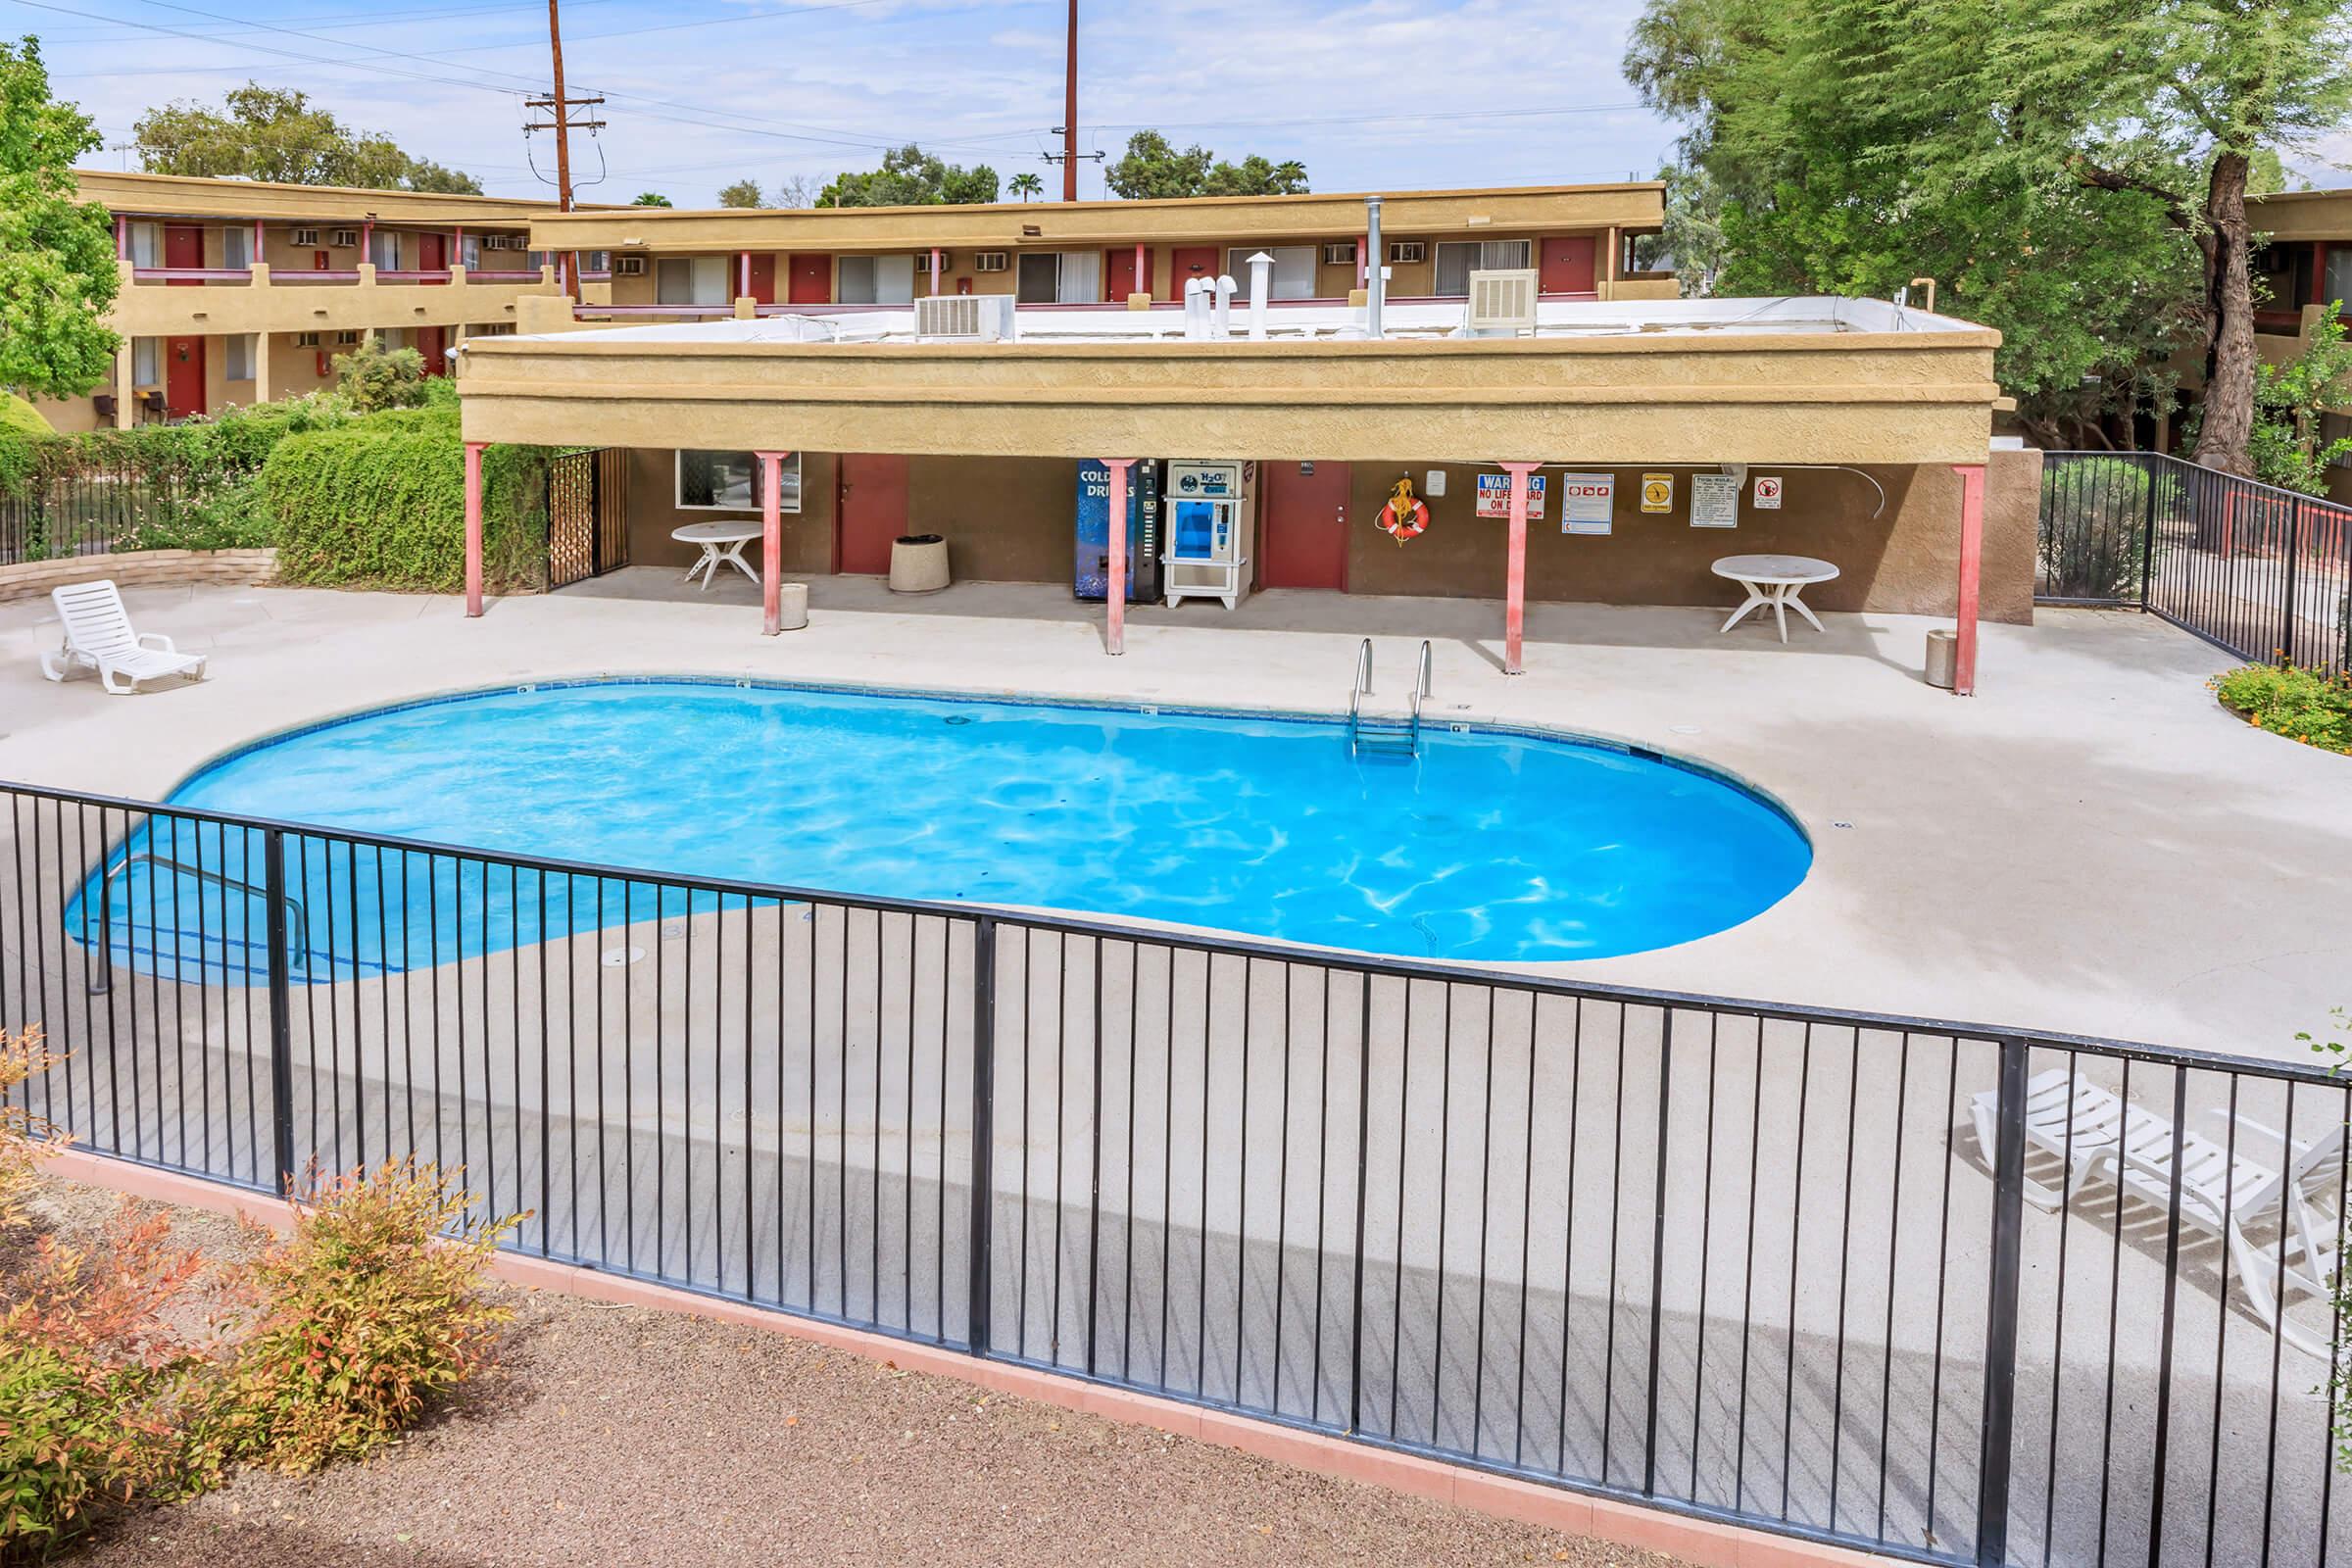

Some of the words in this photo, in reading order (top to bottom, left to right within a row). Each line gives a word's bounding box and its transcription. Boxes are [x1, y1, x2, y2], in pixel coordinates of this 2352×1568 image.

[1087, 485, 1135, 497] DRIS
[1479, 489, 1492, 499] NO
[1491, 500, 1502, 510] ON
